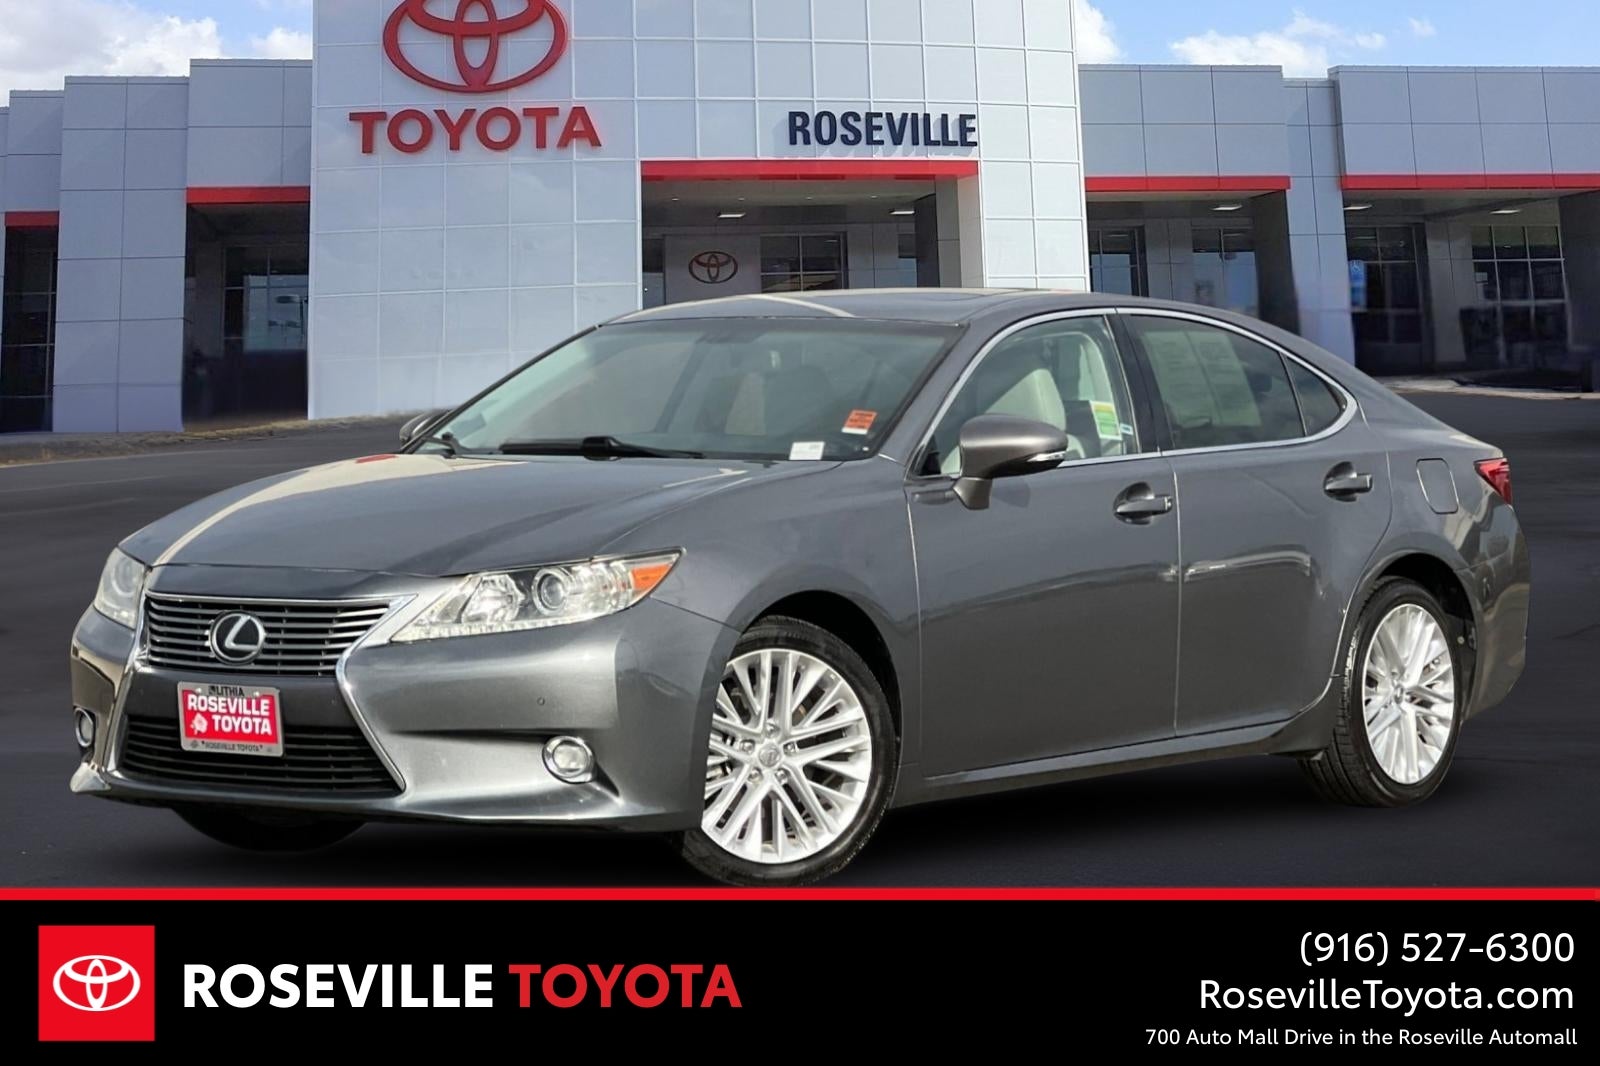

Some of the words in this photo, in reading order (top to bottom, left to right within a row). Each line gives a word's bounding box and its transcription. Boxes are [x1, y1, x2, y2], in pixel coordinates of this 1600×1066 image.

[349, 106, 602, 154] TOYOTA
[788, 111, 978, 147] ROSEVILLE
[216, 686, 245, 697] LITHIA
[187, 694, 270, 716] ROSEVILLE
[211, 714, 272, 735] TOYOTA
